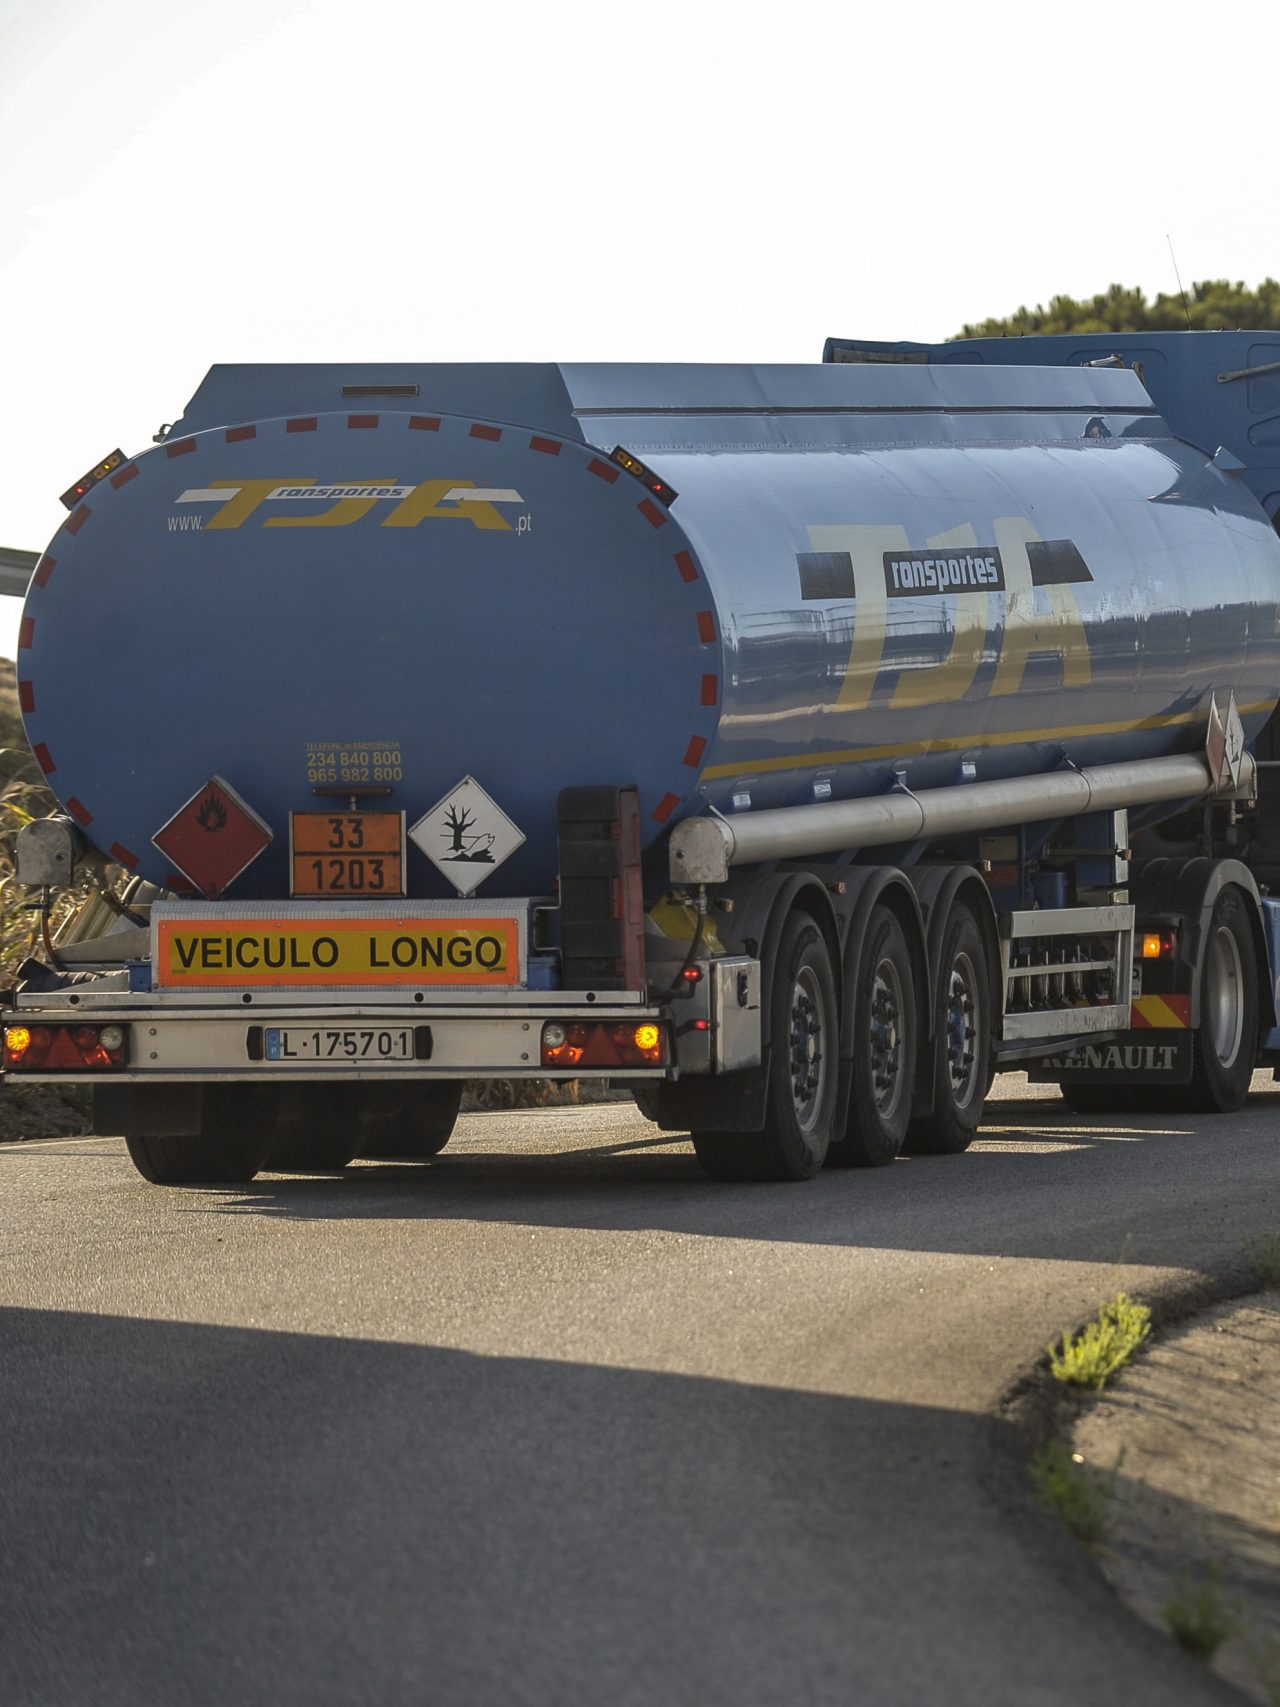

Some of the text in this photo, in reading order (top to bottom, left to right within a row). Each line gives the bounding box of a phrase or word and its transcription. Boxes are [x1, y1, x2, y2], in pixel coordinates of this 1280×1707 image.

[203, 478, 513, 531] TJA
[891, 554, 999, 592] ransportes
[307, 751, 401, 767] 234 840 800
[308, 767, 403, 783] 965 982 800
[328, 818, 364, 849] 33
[312, 859, 384, 890] 1203
[175, 936, 503, 968] VEICULO LONGO
